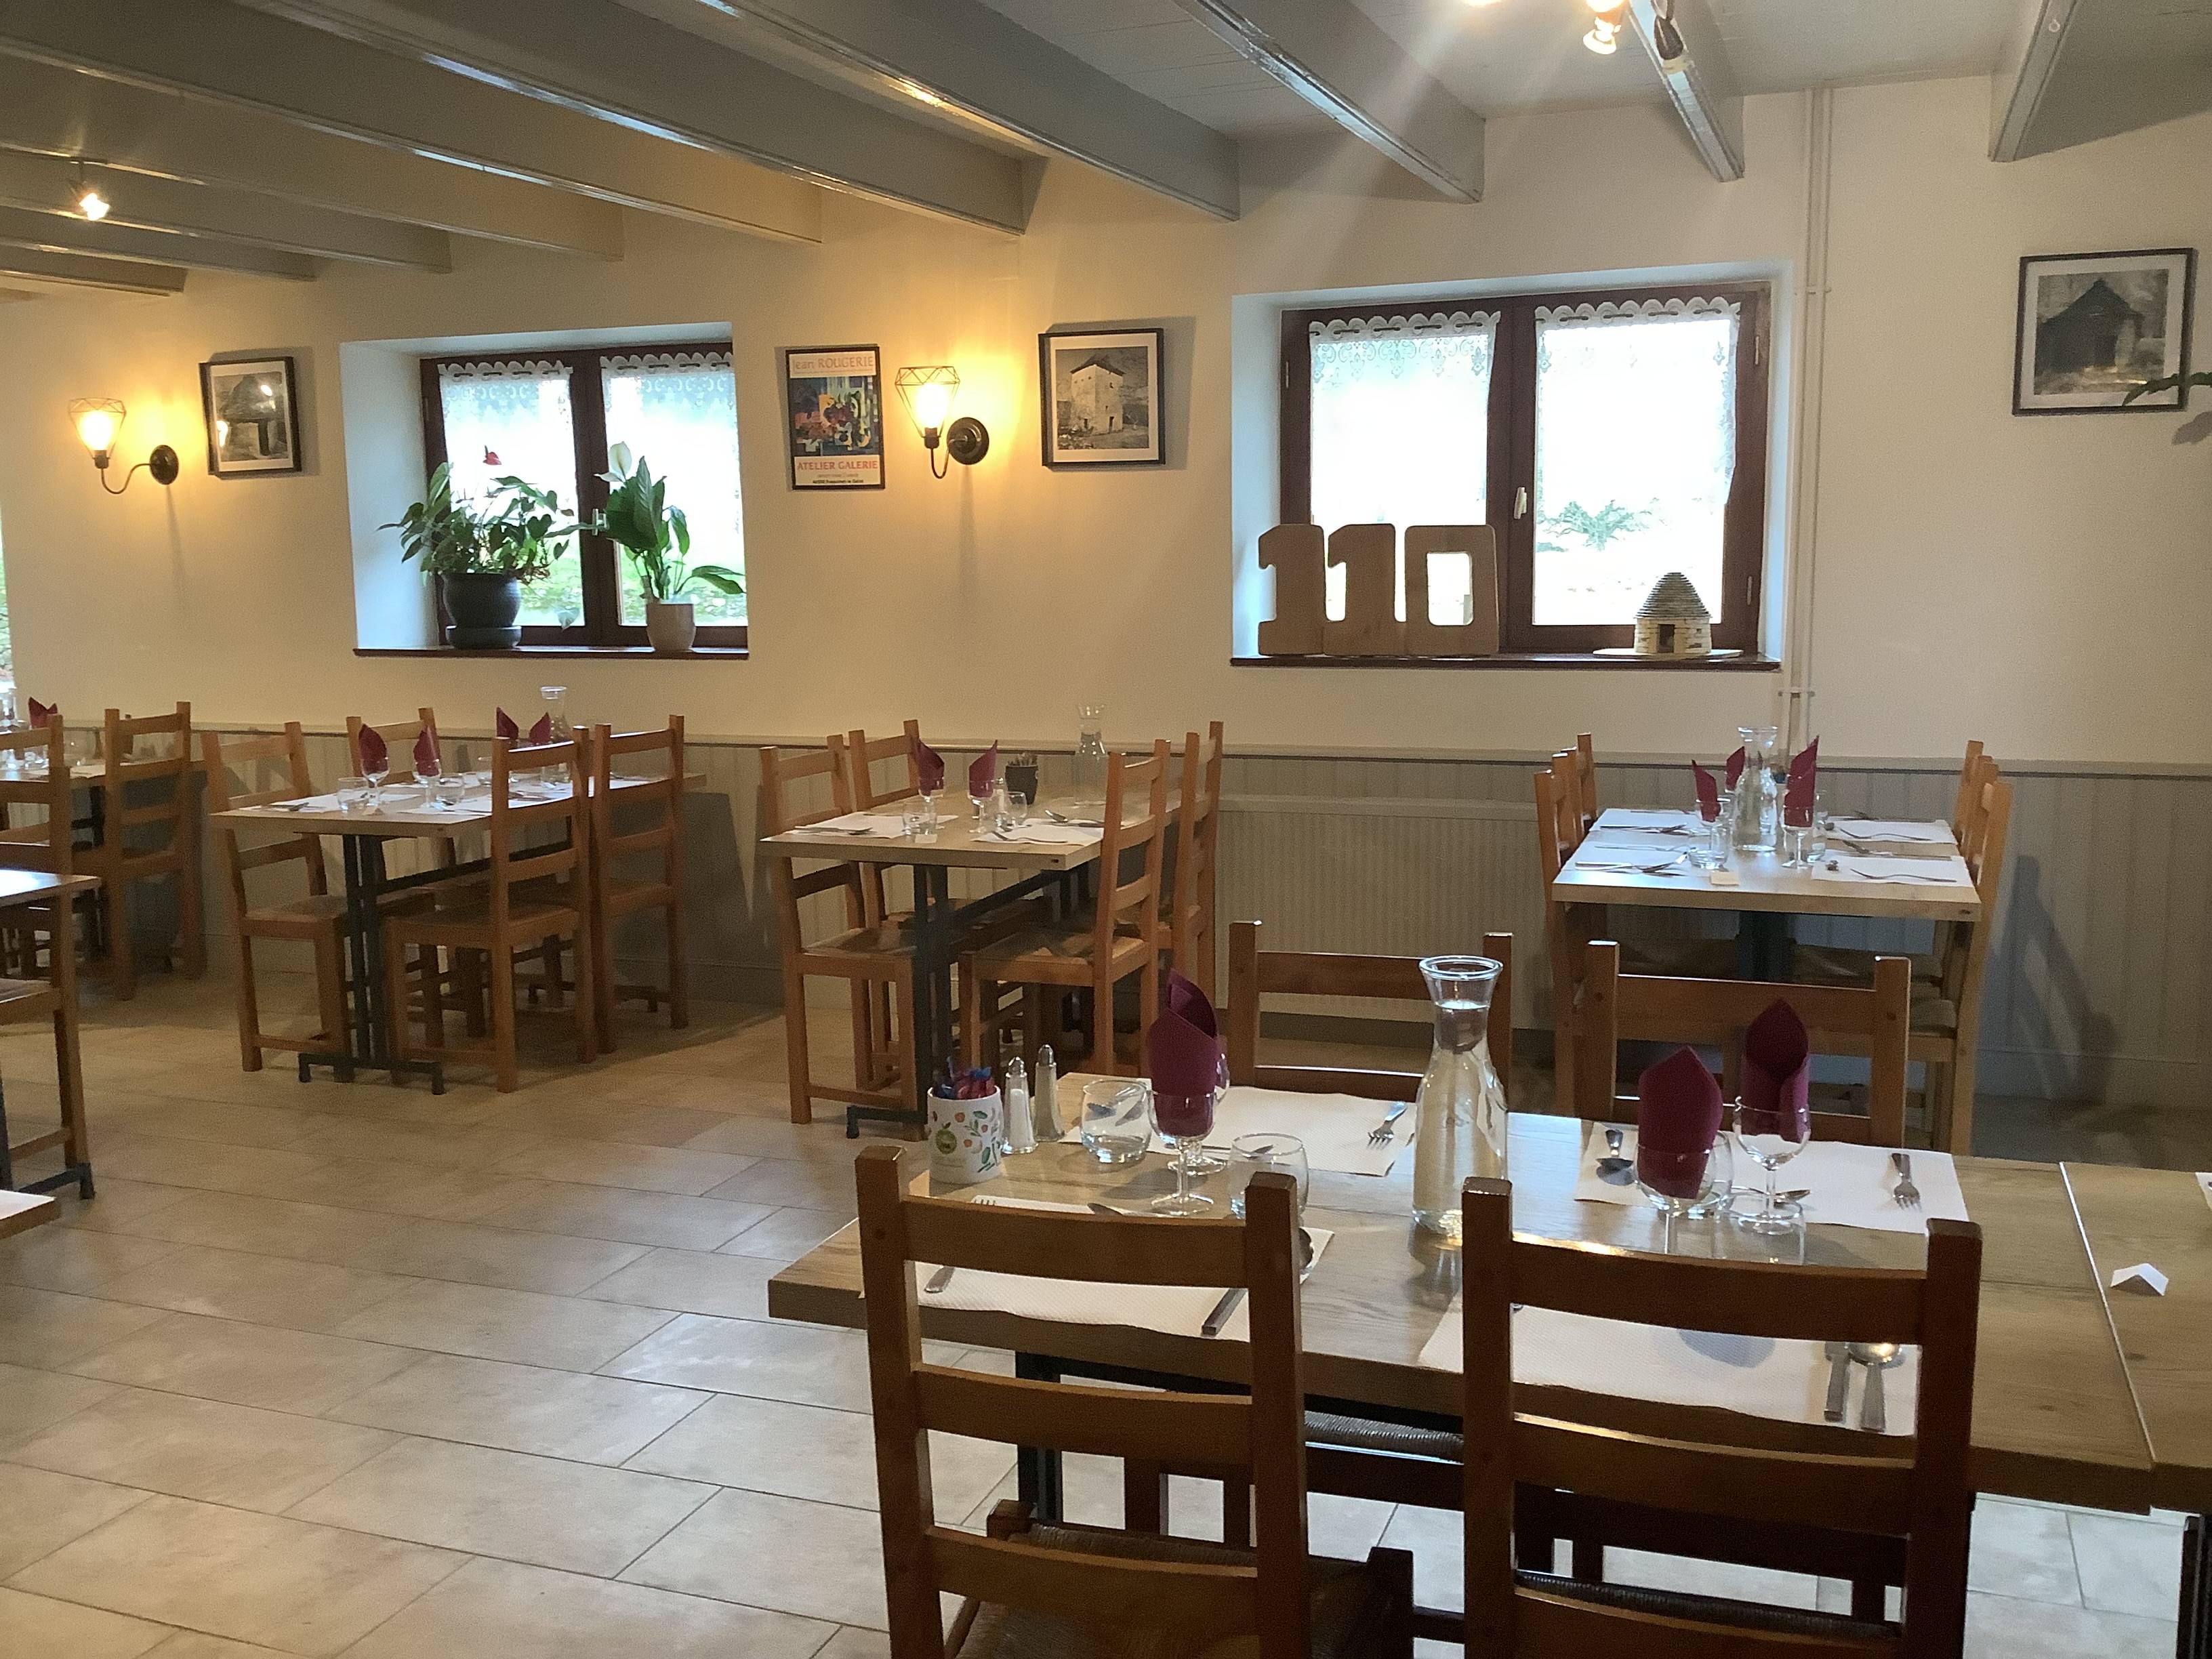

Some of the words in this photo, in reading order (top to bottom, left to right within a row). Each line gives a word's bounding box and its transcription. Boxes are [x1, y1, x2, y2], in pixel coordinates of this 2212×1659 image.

[792, 359, 815, 371] Jean
[818, 356, 874, 368] ROUGERIE
[797, 462, 835, 470] ATELIER
[838, 461, 878, 470] GALERIE
[1258, 523, 1499, 656] 110
